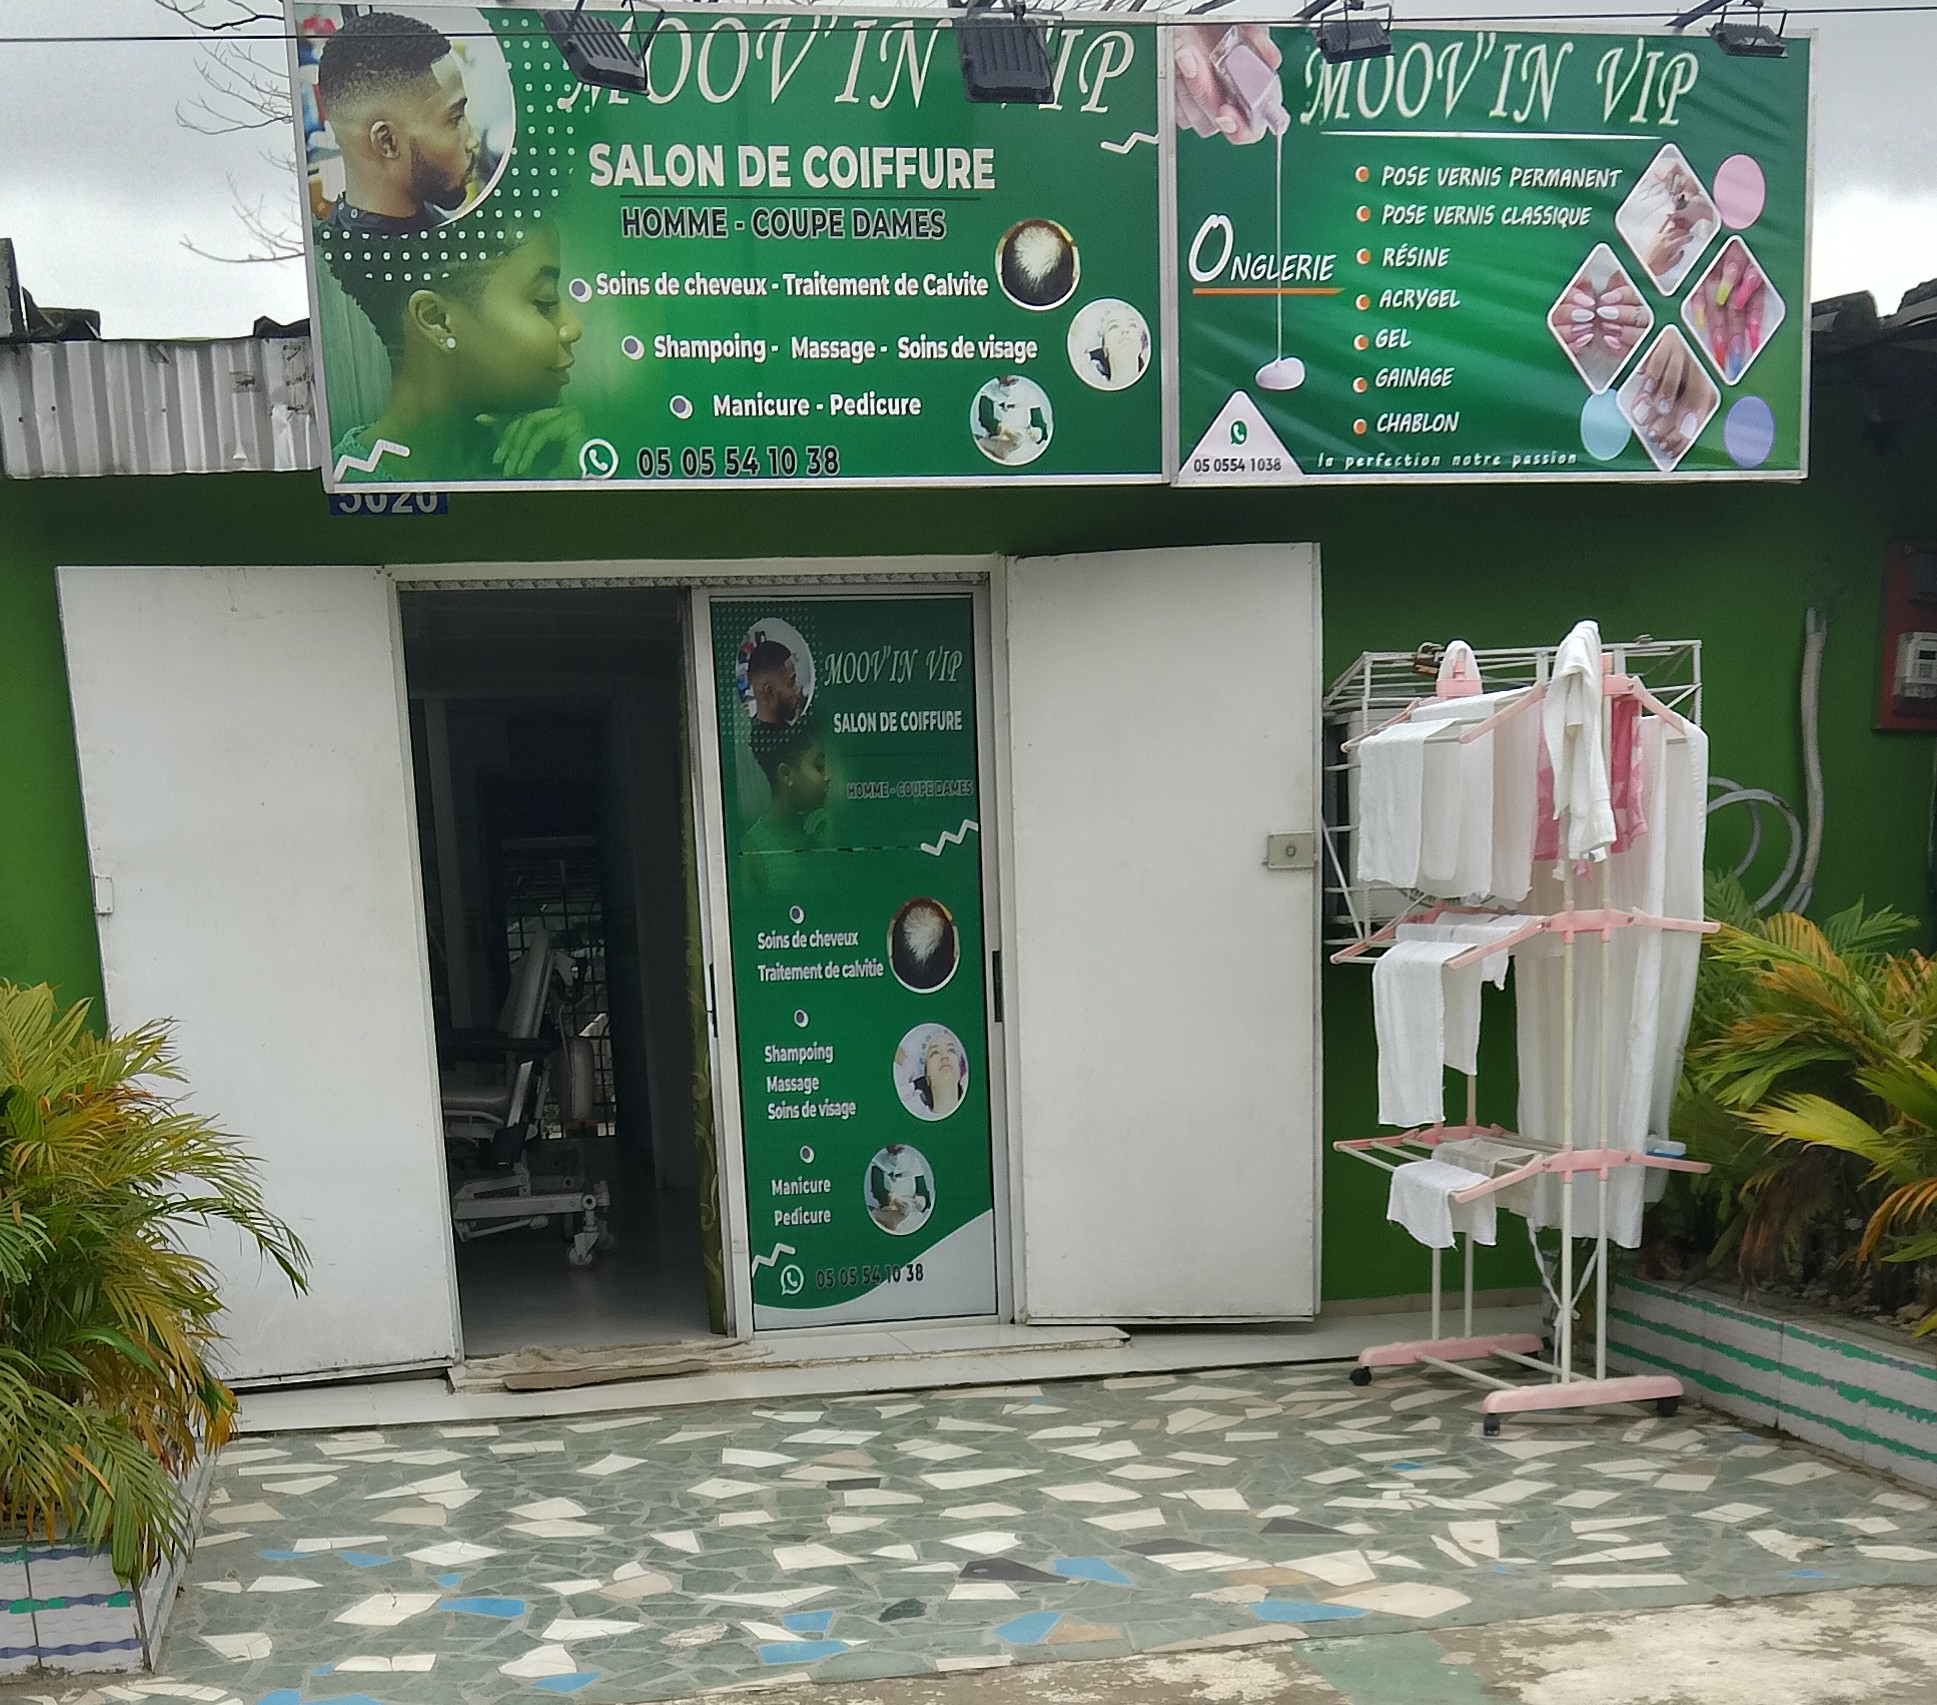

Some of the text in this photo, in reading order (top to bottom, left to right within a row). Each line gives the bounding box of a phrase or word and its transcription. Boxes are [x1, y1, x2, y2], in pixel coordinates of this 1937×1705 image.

[1596, 38, 1699, 126] VIP
[589, 144, 995, 189] SALON DE COIFFURE
[1381, 165, 1623, 189] POSE VERNIS PERMANENT
[621, 206, 947, 241] HOMME - COUPE DAMES
[1381, 205, 1593, 228] POSE VERNIS CLASSIQUE
[1188, 214, 1337, 283] ONGLERIE
[1382, 243, 1451, 267] RÉSINE
[596, 270, 650, 296] Soins
[655, 271, 680, 296] de
[684, 271, 767, 296] cheveux
[782, 271, 890, 296] Traitement
[895, 273, 919, 296] de
[923, 271, 989, 296] Calvite
[1379, 288, 1460, 311] ACRYGEL
[654, 333, 766, 364] Shampoing
[791, 336, 876, 364] Massage
[898, 334, 948, 359] Soins
[951, 336, 975, 359] de
[978, 334, 1038, 365] visage
[1375, 329, 1411, 349] GEL
[1375, 367, 1455, 388] GAINAGE
[713, 391, 809, 416] Manicure
[830, 391, 922, 416] Pedicure
[1376, 411, 1460, 433] CHABLON
[637, 446, 840, 478] 05 05 54 10 38
[1193, 457, 1282, 472] 05 0554 1038
[1318, 450, 1577, 471] la perfection notre passion
[926, 645, 963, 683] VIP
[834, 710, 963, 733] SALON DE COIFFURE
[847, 782, 889, 799] HOMME
[896, 780, 934, 797] COUPE
[934, 779, 974, 796] DAMES
[757, 930, 858, 949] Soins de cheveux
[758, 958, 884, 982] Traitement de calvitie
[764, 1041, 834, 1065] Shampoing
[766, 1075, 819, 1095] Massage
[767, 1098, 857, 1120] Soins de visage
[771, 1175, 831, 1196] Manicure
[774, 1206, 831, 1227] Pedicure
[816, 1263, 924, 1289] 05 05 54 10 38
